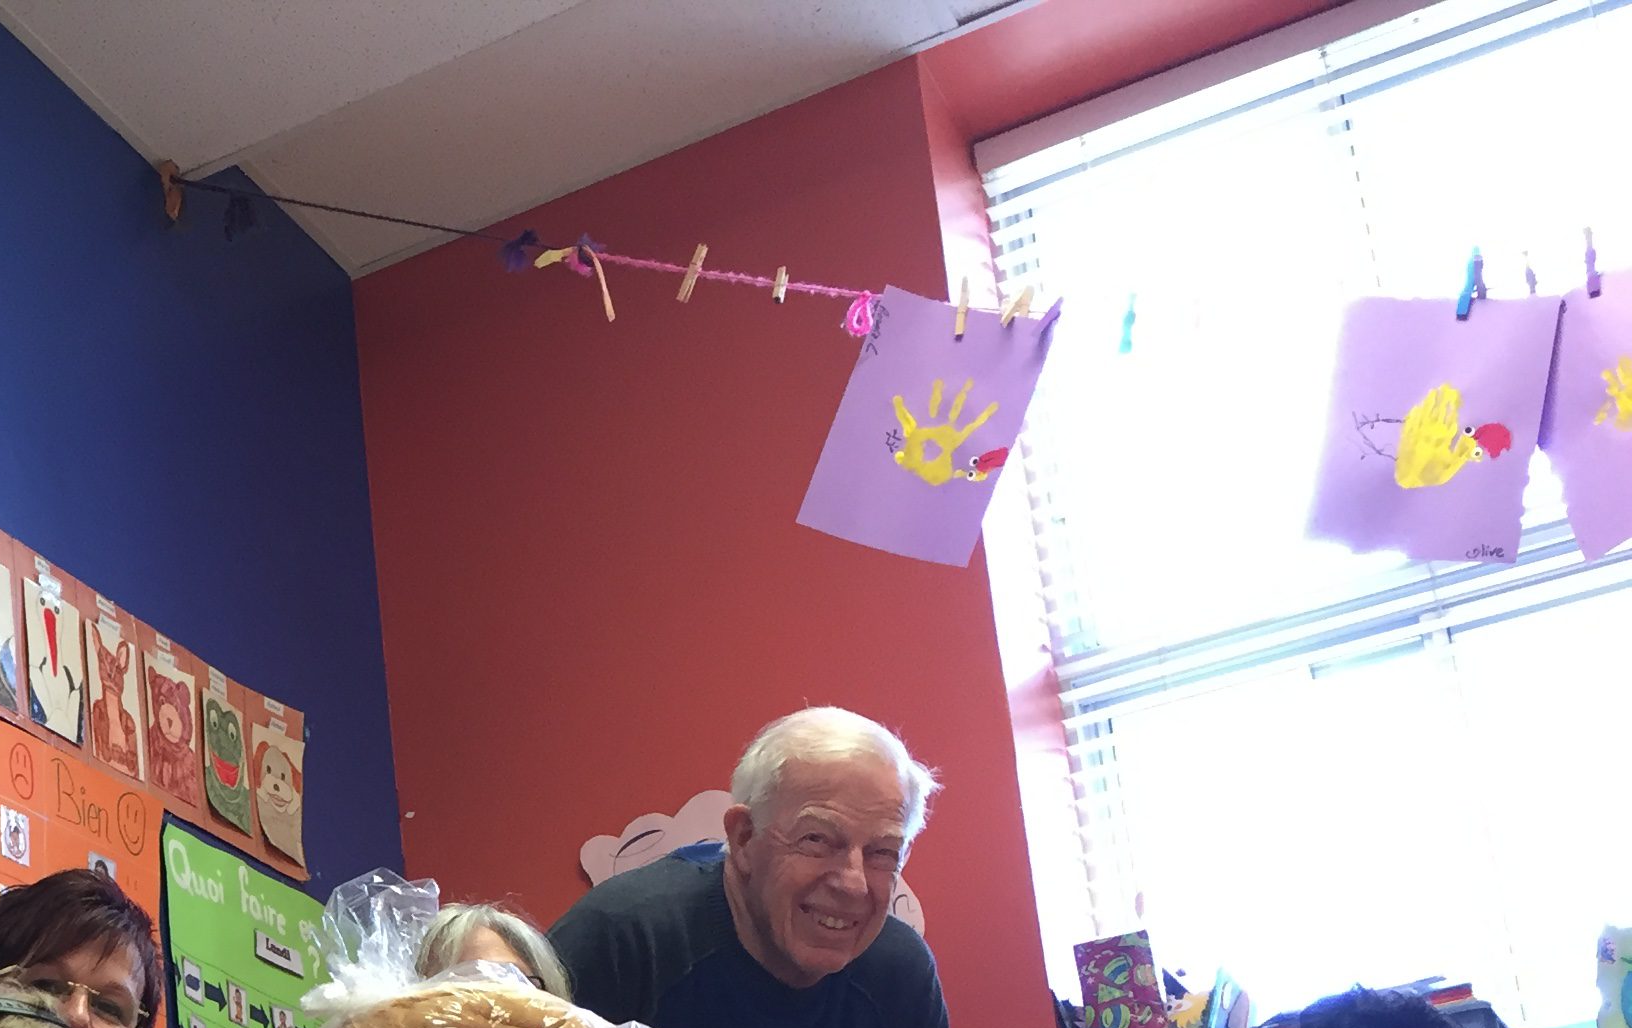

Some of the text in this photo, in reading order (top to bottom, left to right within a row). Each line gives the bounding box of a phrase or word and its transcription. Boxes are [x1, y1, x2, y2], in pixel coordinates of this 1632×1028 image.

[51, 757, 112, 843] Bien
[168, 838, 225, 905] Quoi
[237, 865, 287, 936] faire
